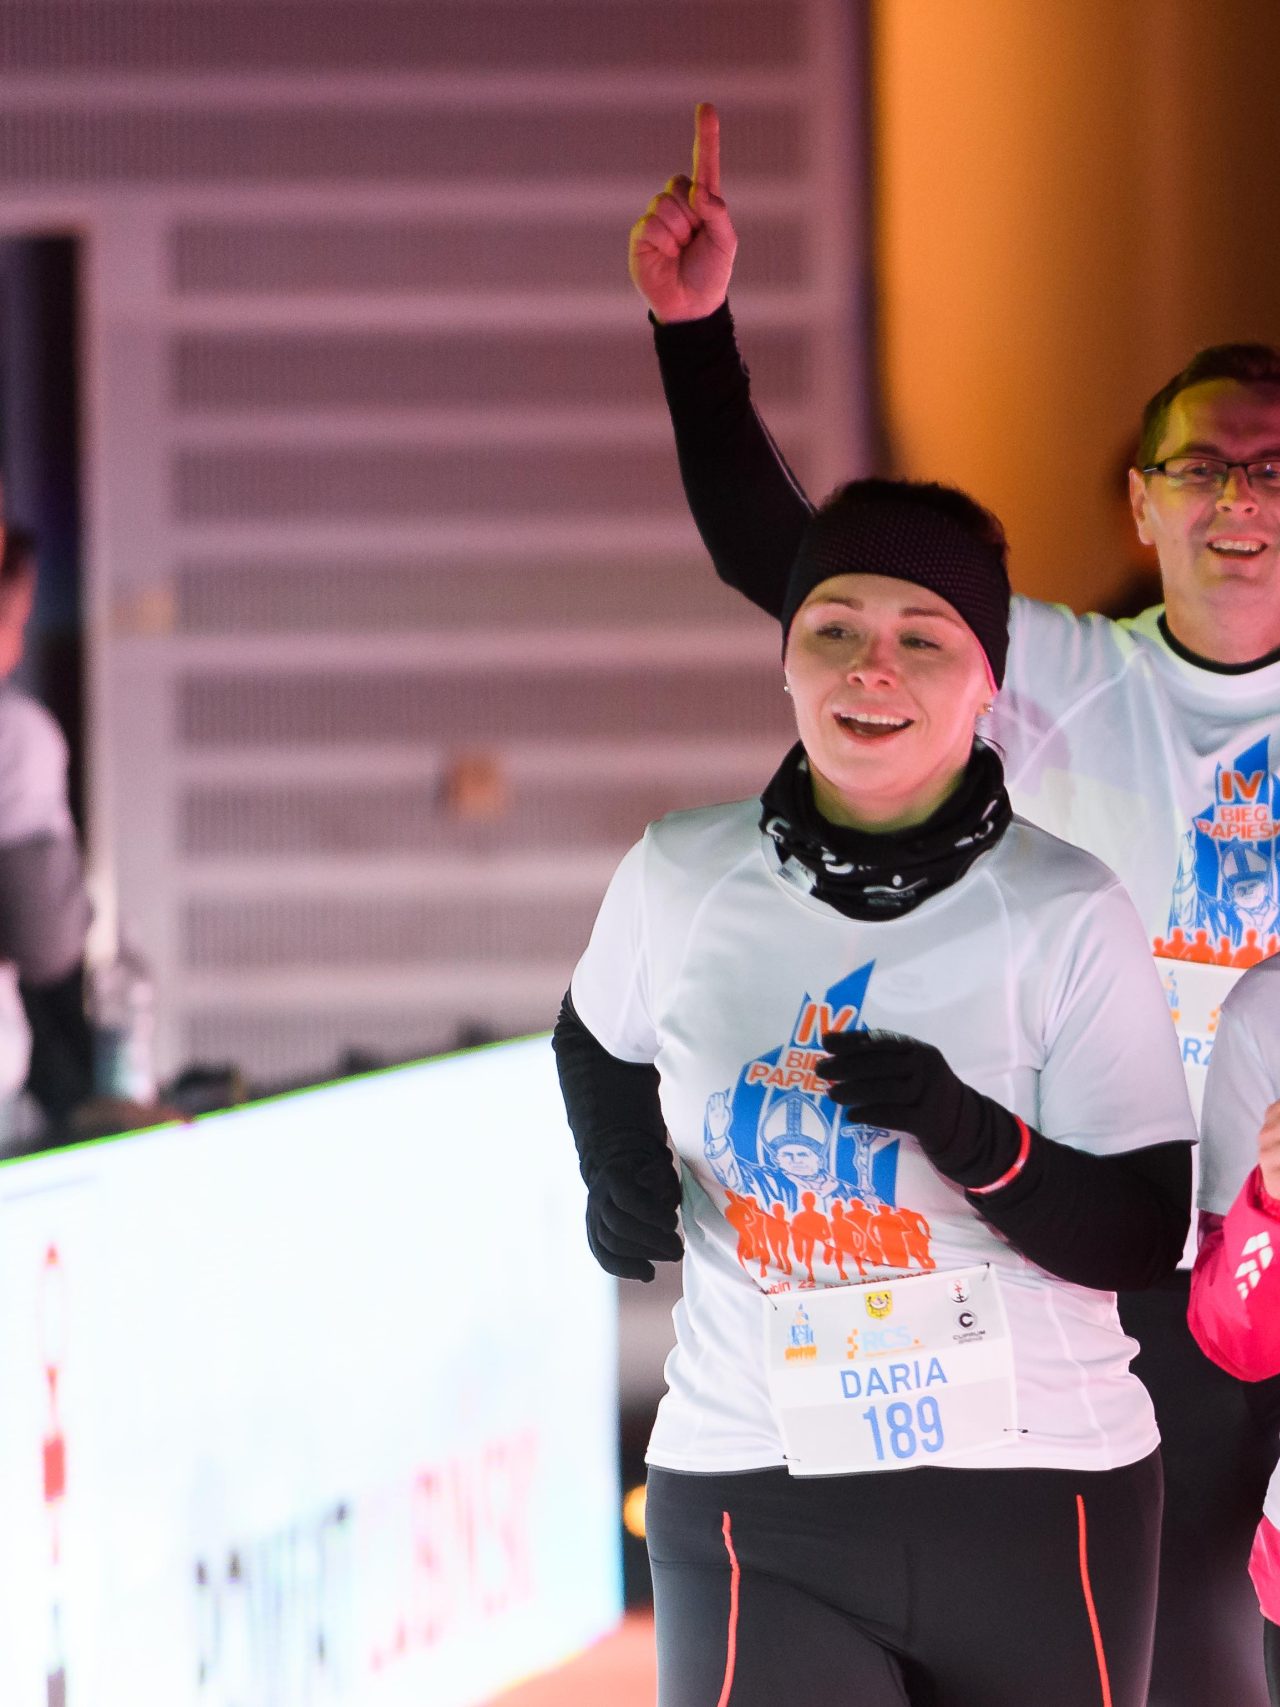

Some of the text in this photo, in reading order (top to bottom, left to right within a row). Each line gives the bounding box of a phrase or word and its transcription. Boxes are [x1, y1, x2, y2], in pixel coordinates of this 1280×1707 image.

[1220, 770, 1264, 800] IV
[1220, 805, 1268, 823] BIEG
[798, 1004, 853, 1042] IV
[745, 1064, 832, 1092] PAPIE
[840, 1357, 948, 1399] DARIA
[862, 1395, 945, 1461] 189
